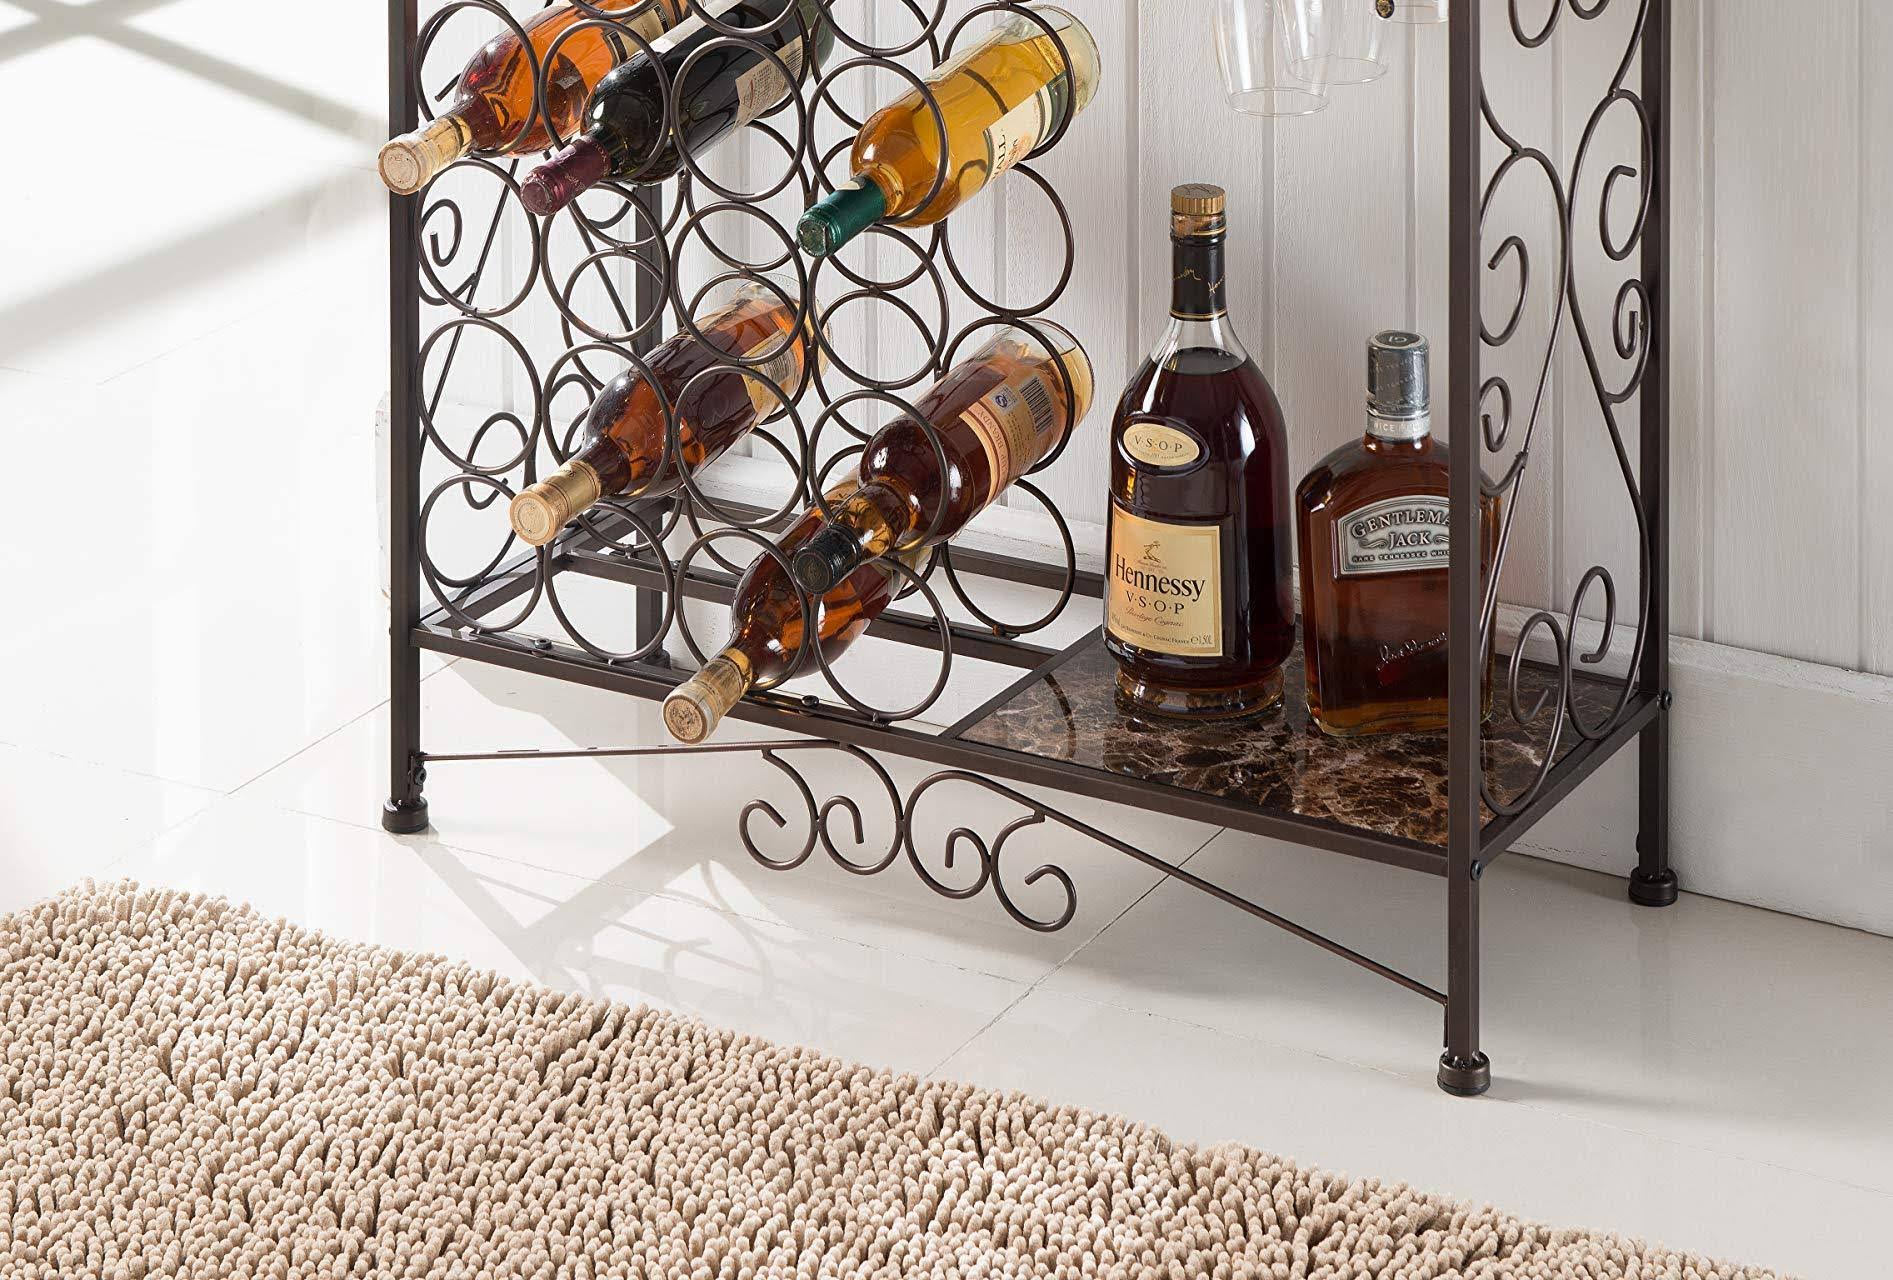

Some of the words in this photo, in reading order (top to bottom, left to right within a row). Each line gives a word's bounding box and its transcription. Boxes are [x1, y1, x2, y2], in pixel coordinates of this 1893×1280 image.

[1388, 531, 1431, 550] JACK
[1378, 551, 1428, 561] TENNESSEE
[1115, 552, 1205, 602] Hennessy
